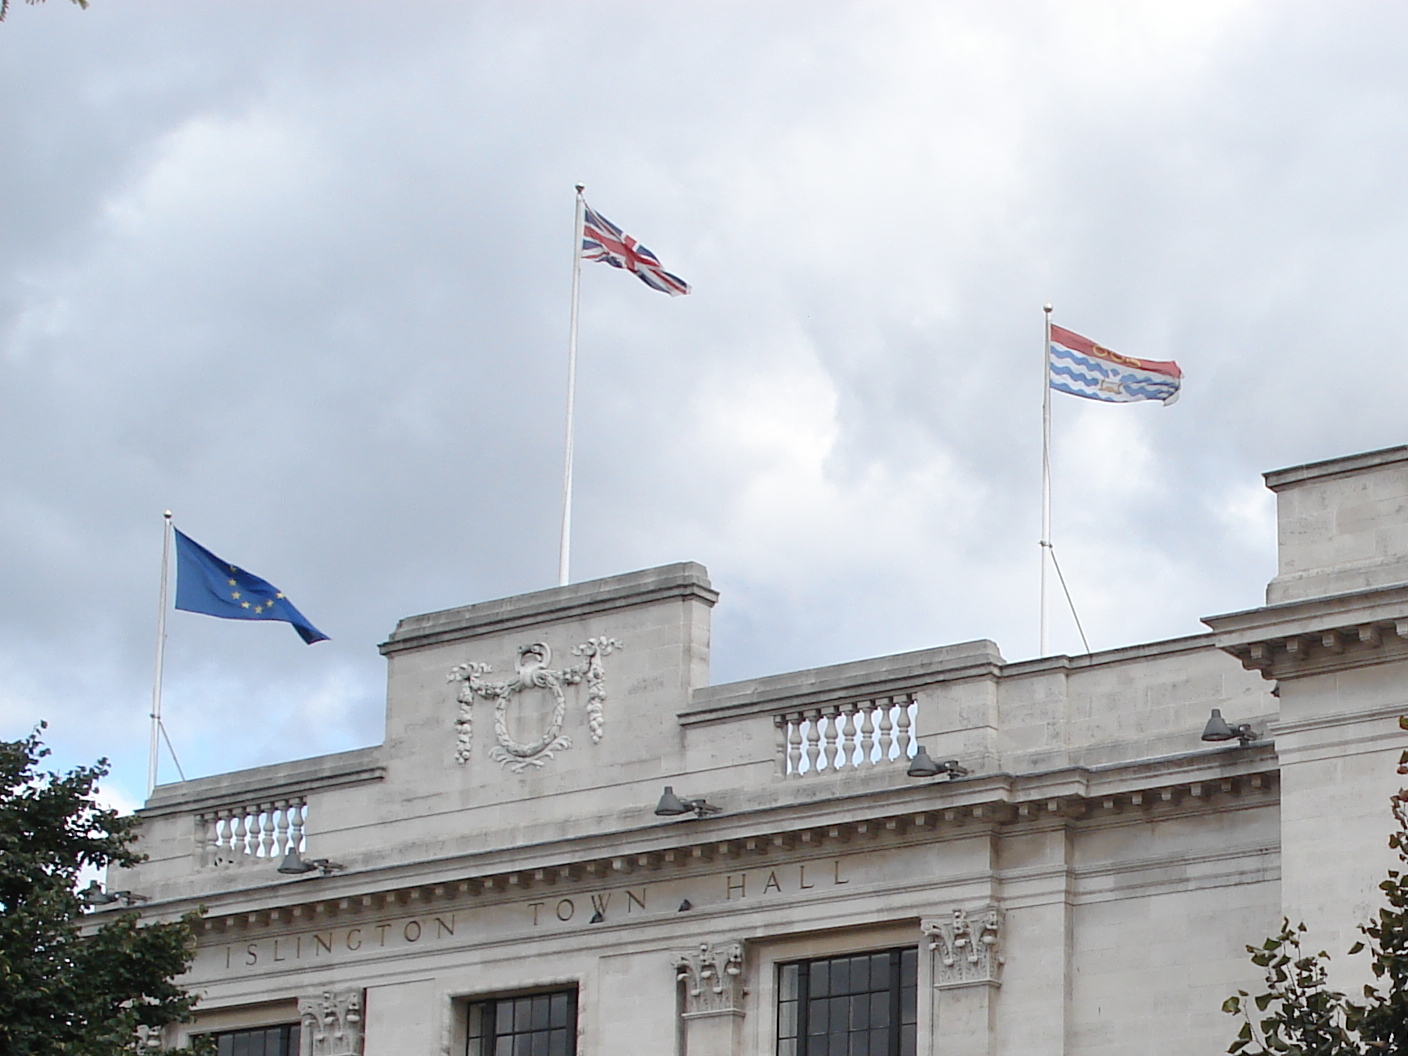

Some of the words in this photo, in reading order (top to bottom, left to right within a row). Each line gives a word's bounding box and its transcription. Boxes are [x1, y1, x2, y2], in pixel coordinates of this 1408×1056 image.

[225, 914, 456, 969] ISLINGTON
[528, 887, 647, 926] TOWN
[726, 860, 849, 900] HALL
